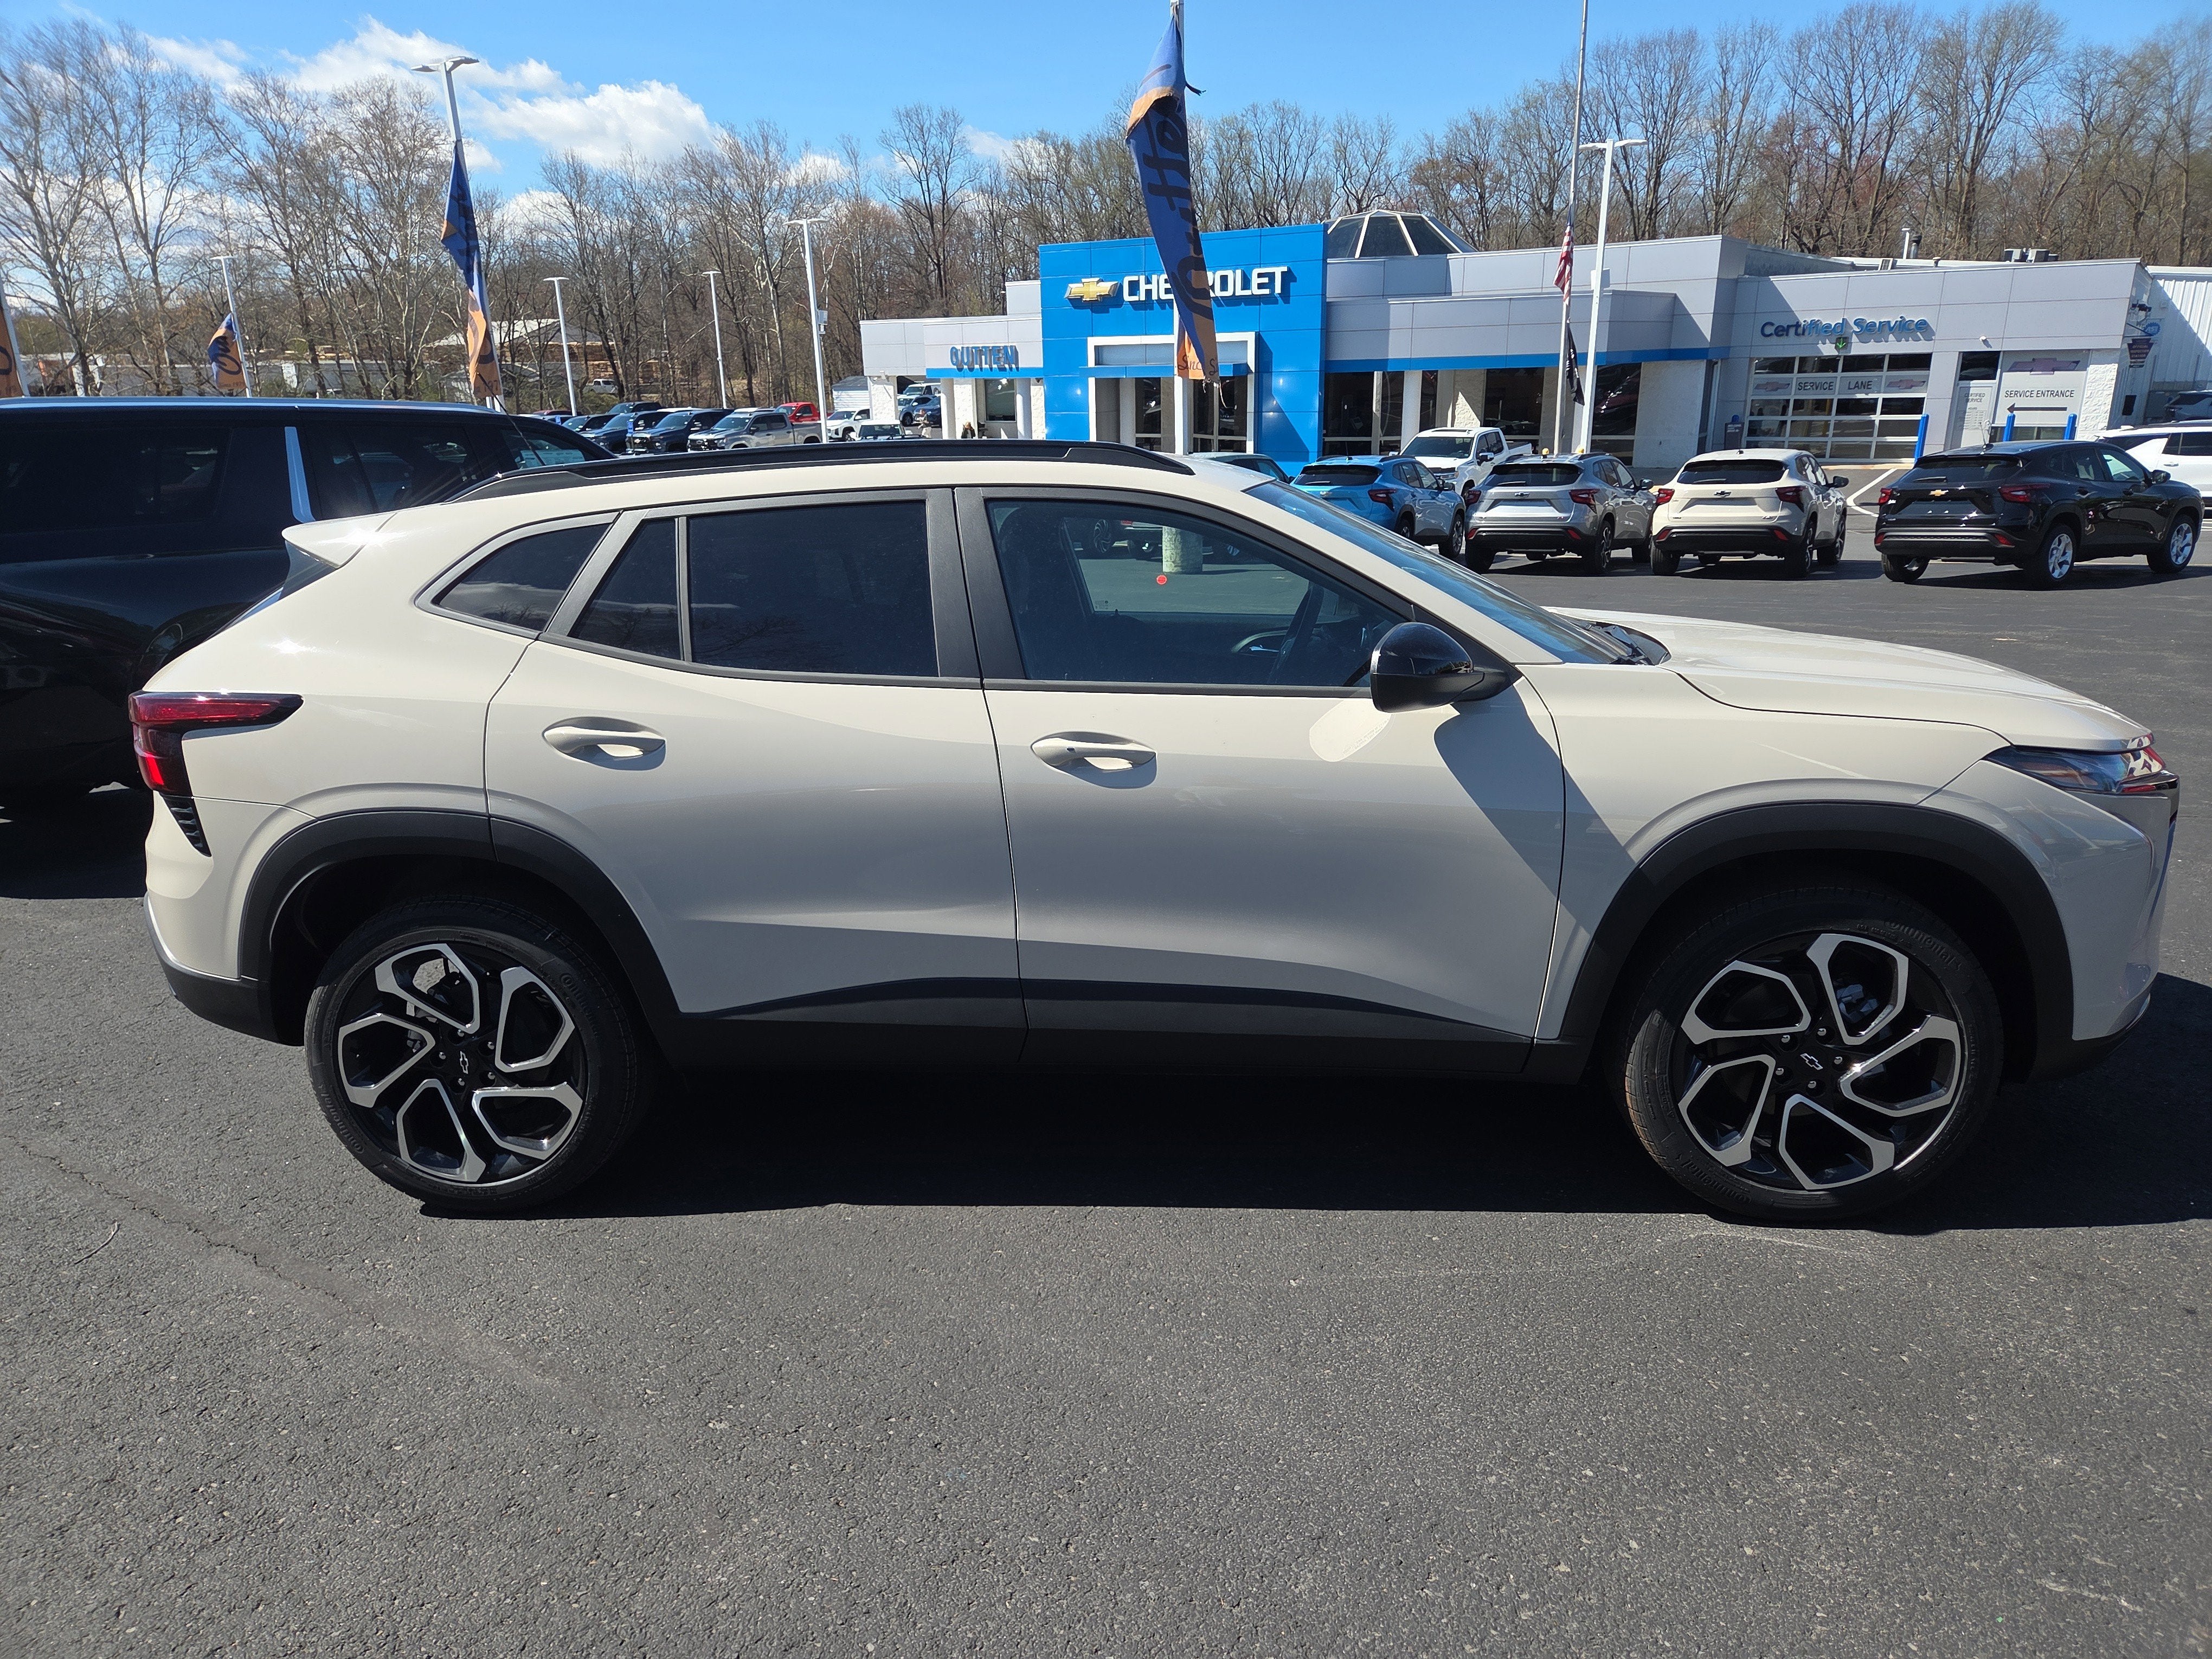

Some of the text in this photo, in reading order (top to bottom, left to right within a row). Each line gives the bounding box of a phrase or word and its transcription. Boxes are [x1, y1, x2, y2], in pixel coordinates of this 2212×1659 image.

[1143, 97, 1214, 321] Outte
[1123, 266, 1288, 301] CHEOLET
[1760, 316, 1926, 337] Certified Service
[950, 345, 1017, 366] OUTTEN
[1798, 381, 1873, 391] SERVICE LANE
[2036, 389, 2075, 397] ENTRANCE
[320, 1093, 365, 1154] Continental
